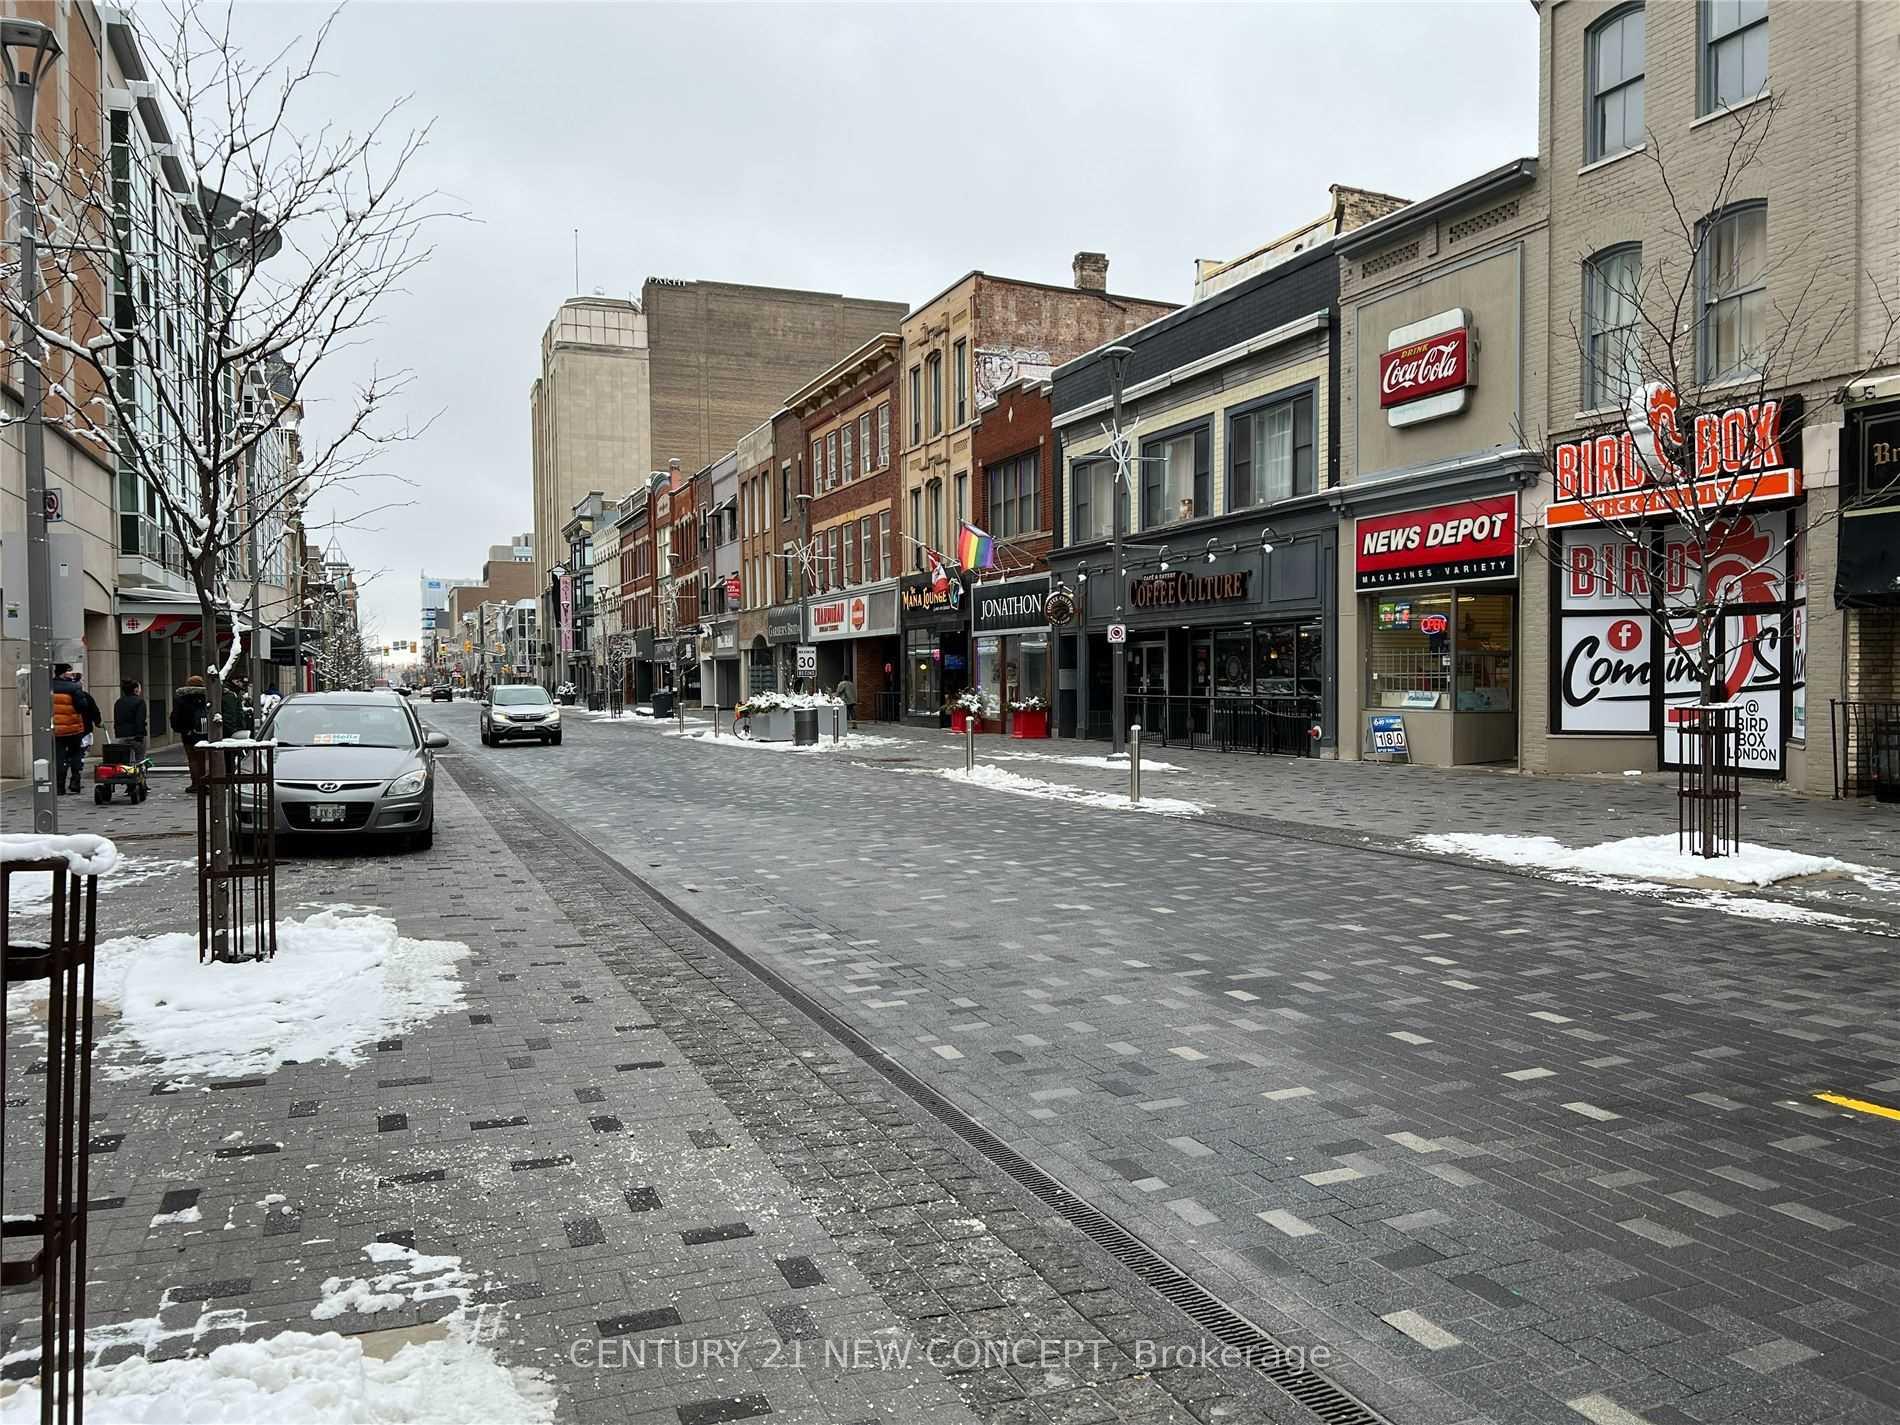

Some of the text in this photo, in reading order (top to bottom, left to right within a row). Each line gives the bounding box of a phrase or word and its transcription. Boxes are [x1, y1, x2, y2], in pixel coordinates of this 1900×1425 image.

[1401, 343, 1429, 358] DRINK
[1694, 402, 1784, 477] BOX
[1363, 512, 1508, 555] NEWS DEPOT
[1362, 561, 1507, 584] MAGAZINES VARIETY
[1570, 543, 1689, 598] BIRD
[1129, 572, 1242, 607] COFFEE CULTURE
[980, 593, 1042, 620] JONATHON
[798, 656, 815, 669] 30
[1745, 699, 1759, 716] @
[1738, 717, 1768, 732] BIRD
[1738, 732, 1766, 748] BOX
